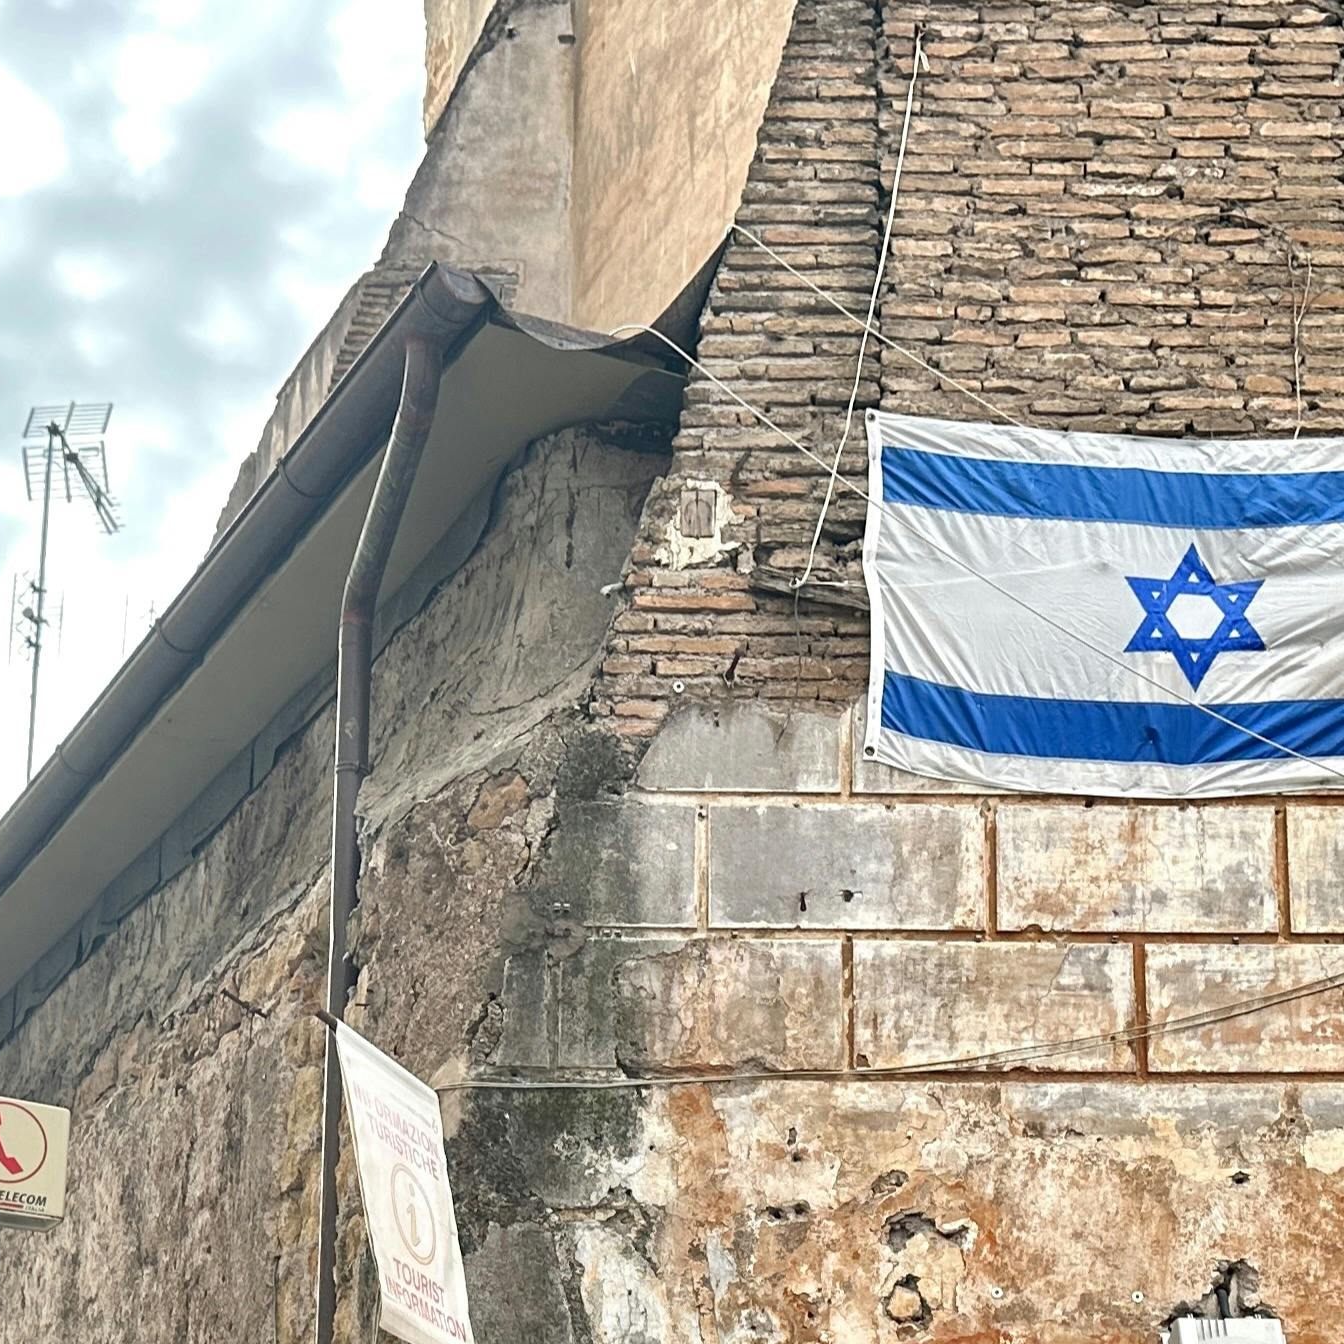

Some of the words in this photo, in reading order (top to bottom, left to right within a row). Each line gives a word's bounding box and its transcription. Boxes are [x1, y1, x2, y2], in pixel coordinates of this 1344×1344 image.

[366, 1111, 440, 1181] TURISTICHE
[385, 1274, 467, 1342] INFORMATION
[393, 1257, 444, 1307] TOURIST
